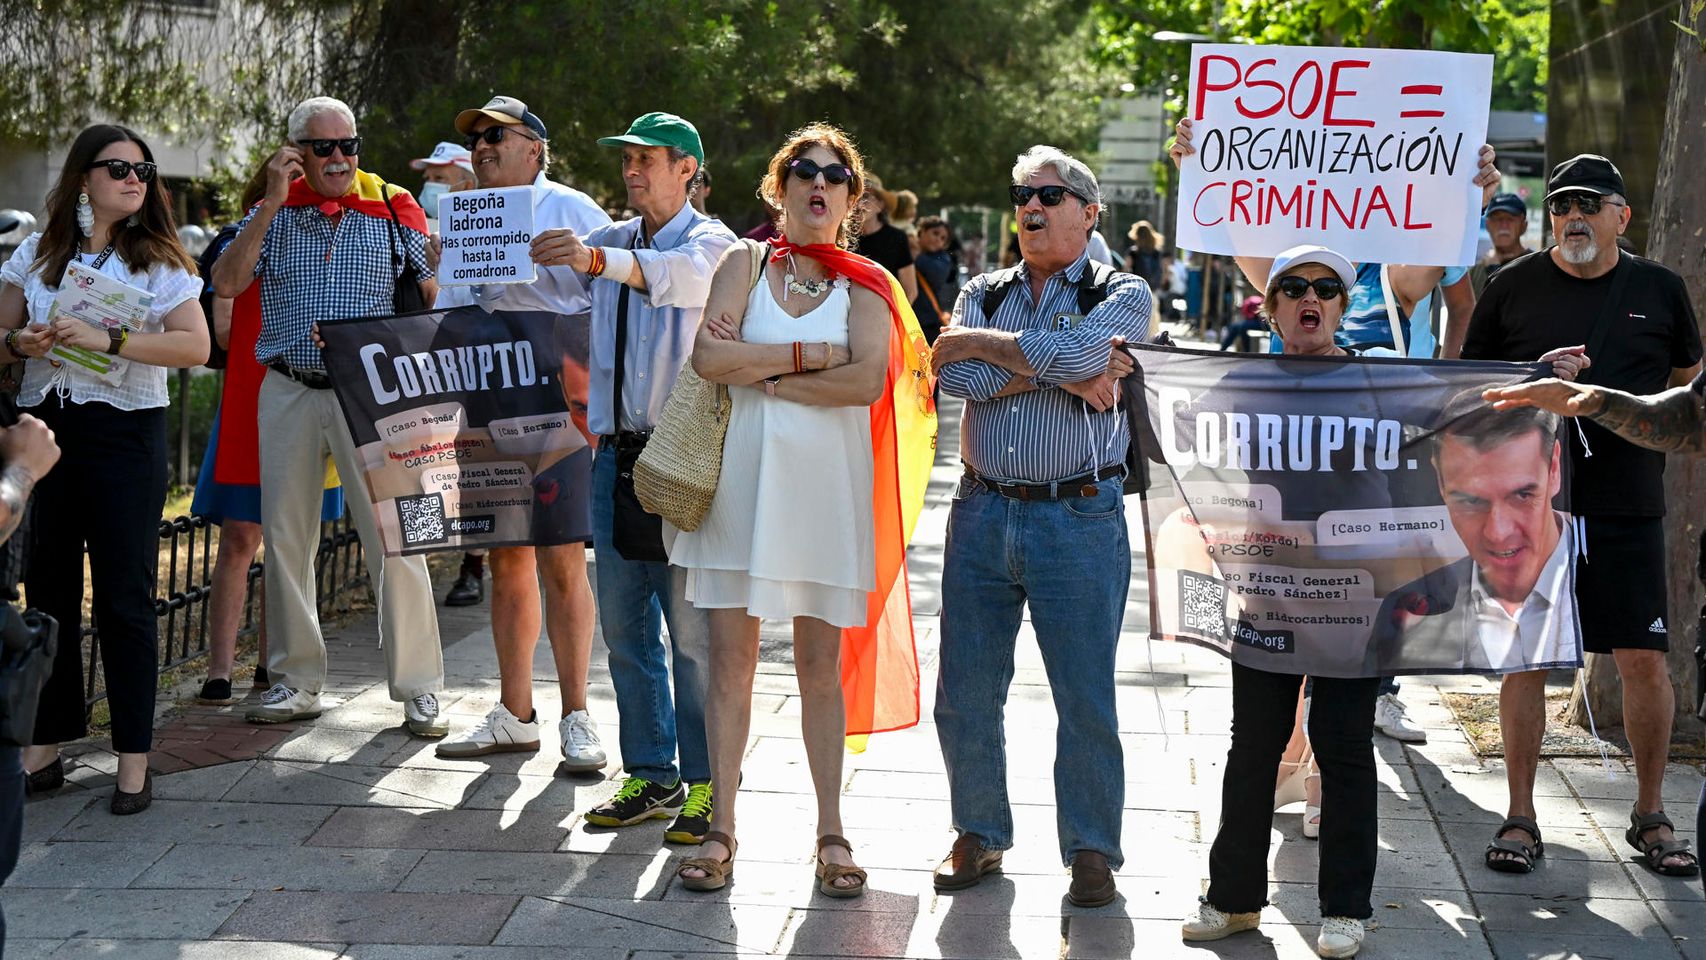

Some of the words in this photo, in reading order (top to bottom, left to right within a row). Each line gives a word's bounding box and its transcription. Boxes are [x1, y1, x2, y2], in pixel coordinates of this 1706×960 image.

[1195, 55, 1375, 128] PSOE
[453, 193, 505, 214] Begoña
[450, 215, 502, 231] ladrona
[441, 236, 459, 249] Has
[462, 230, 531, 247] corrompido
[92, 245, 113, 269] SPACES
[462, 250, 491, 263] hasta
[495, 248, 505, 261] la
[453, 264, 516, 279] comadrona
[437, 448, 472, 460] PSOE
[431, 473, 457, 483] [Caso
[461, 468, 490, 478] Fiscal
[494, 467, 525, 476] General
[441, 482, 452, 490] de
[458, 480, 480, 489] Pedro
[451, 519, 490, 531] elcapo.org
[1332, 523, 1371, 536] [Caso
[1379, 519, 1444, 532] Hermano]
[1220, 543, 1274, 556] PSOE
[1248, 572, 1296, 585] Fiscal
[1303, 576, 1360, 587] General
[1237, 585, 1276, 597] Pedro
[1284, 588, 1348, 600] Sánchez]
[1266, 611, 1370, 626] Hidrocarburos]
[1231, 623, 1285, 650] elcaporg
